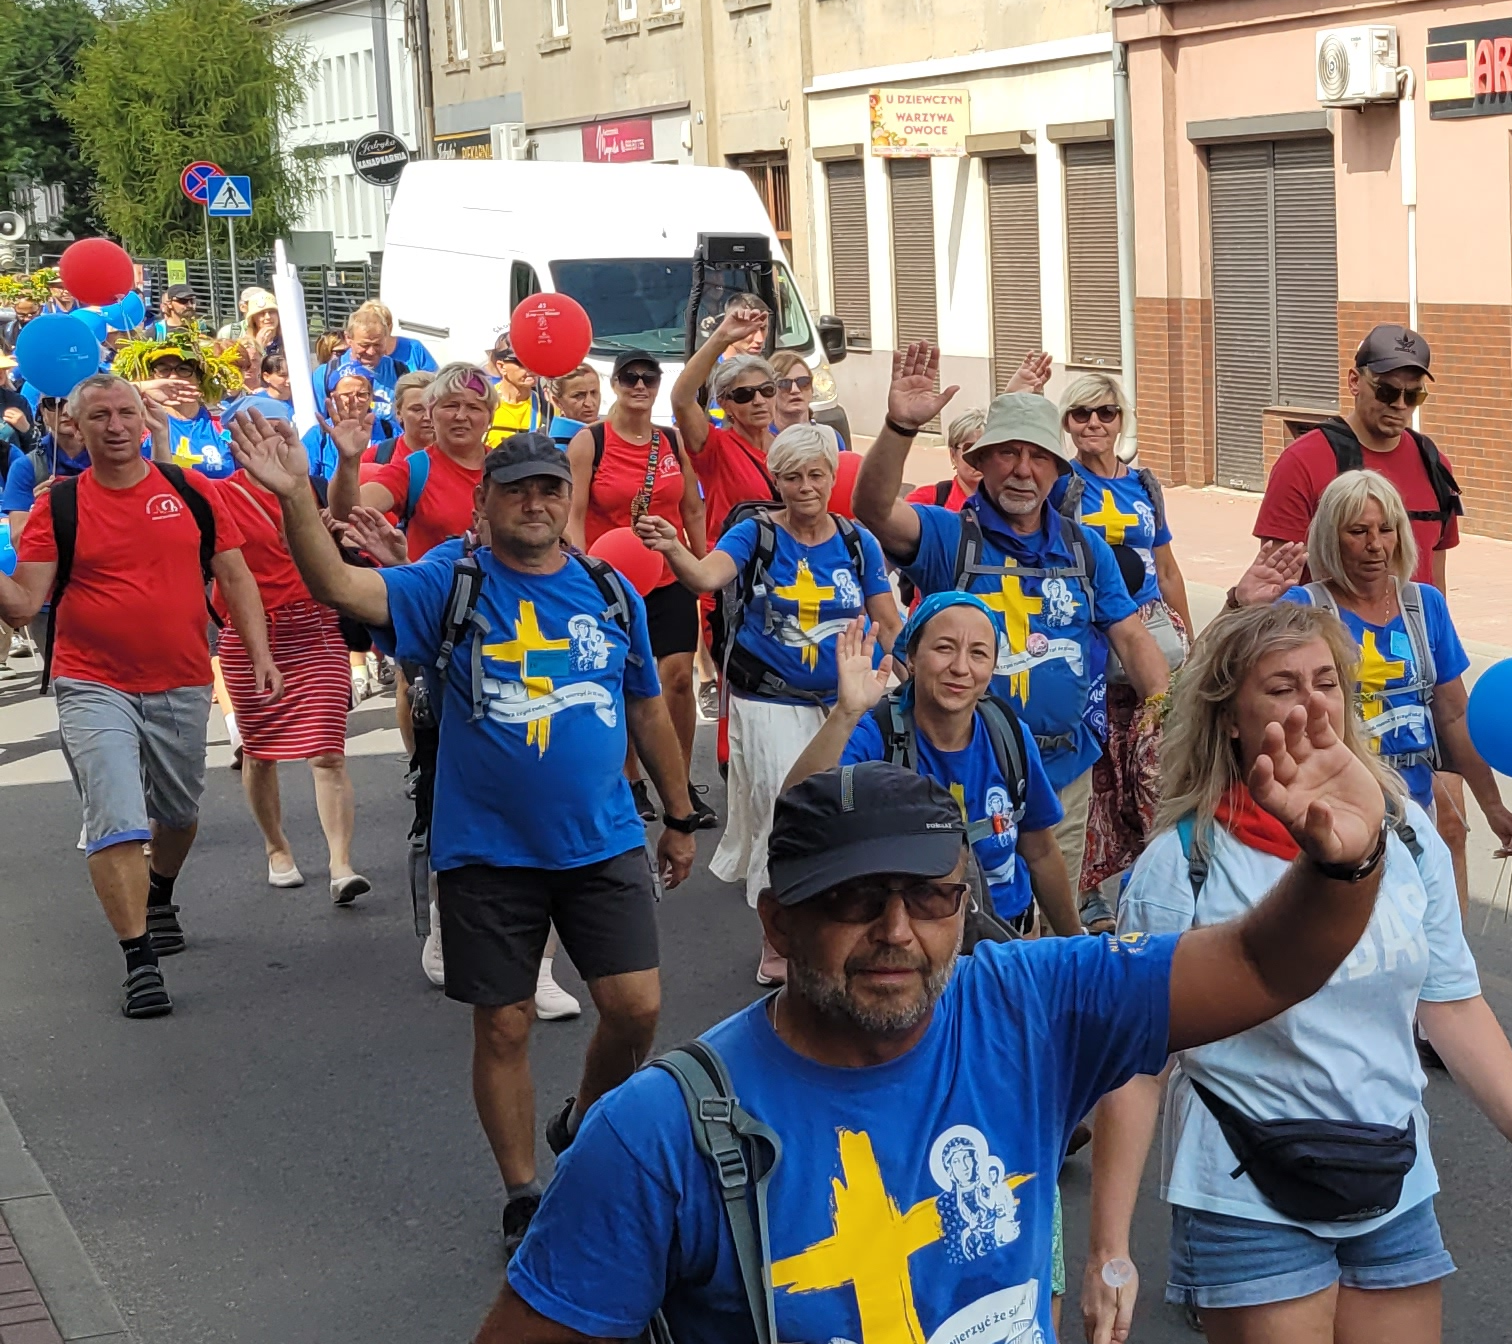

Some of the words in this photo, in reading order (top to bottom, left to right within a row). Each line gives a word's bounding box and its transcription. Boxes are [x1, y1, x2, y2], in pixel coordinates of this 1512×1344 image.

[886, 95, 894, 104] U
[897, 95, 963, 105] DZIEWCZYN
[896, 112, 955, 123] WARZYWA
[903, 125, 948, 135] OWOCE
[990, 1311, 1007, 1325] że
